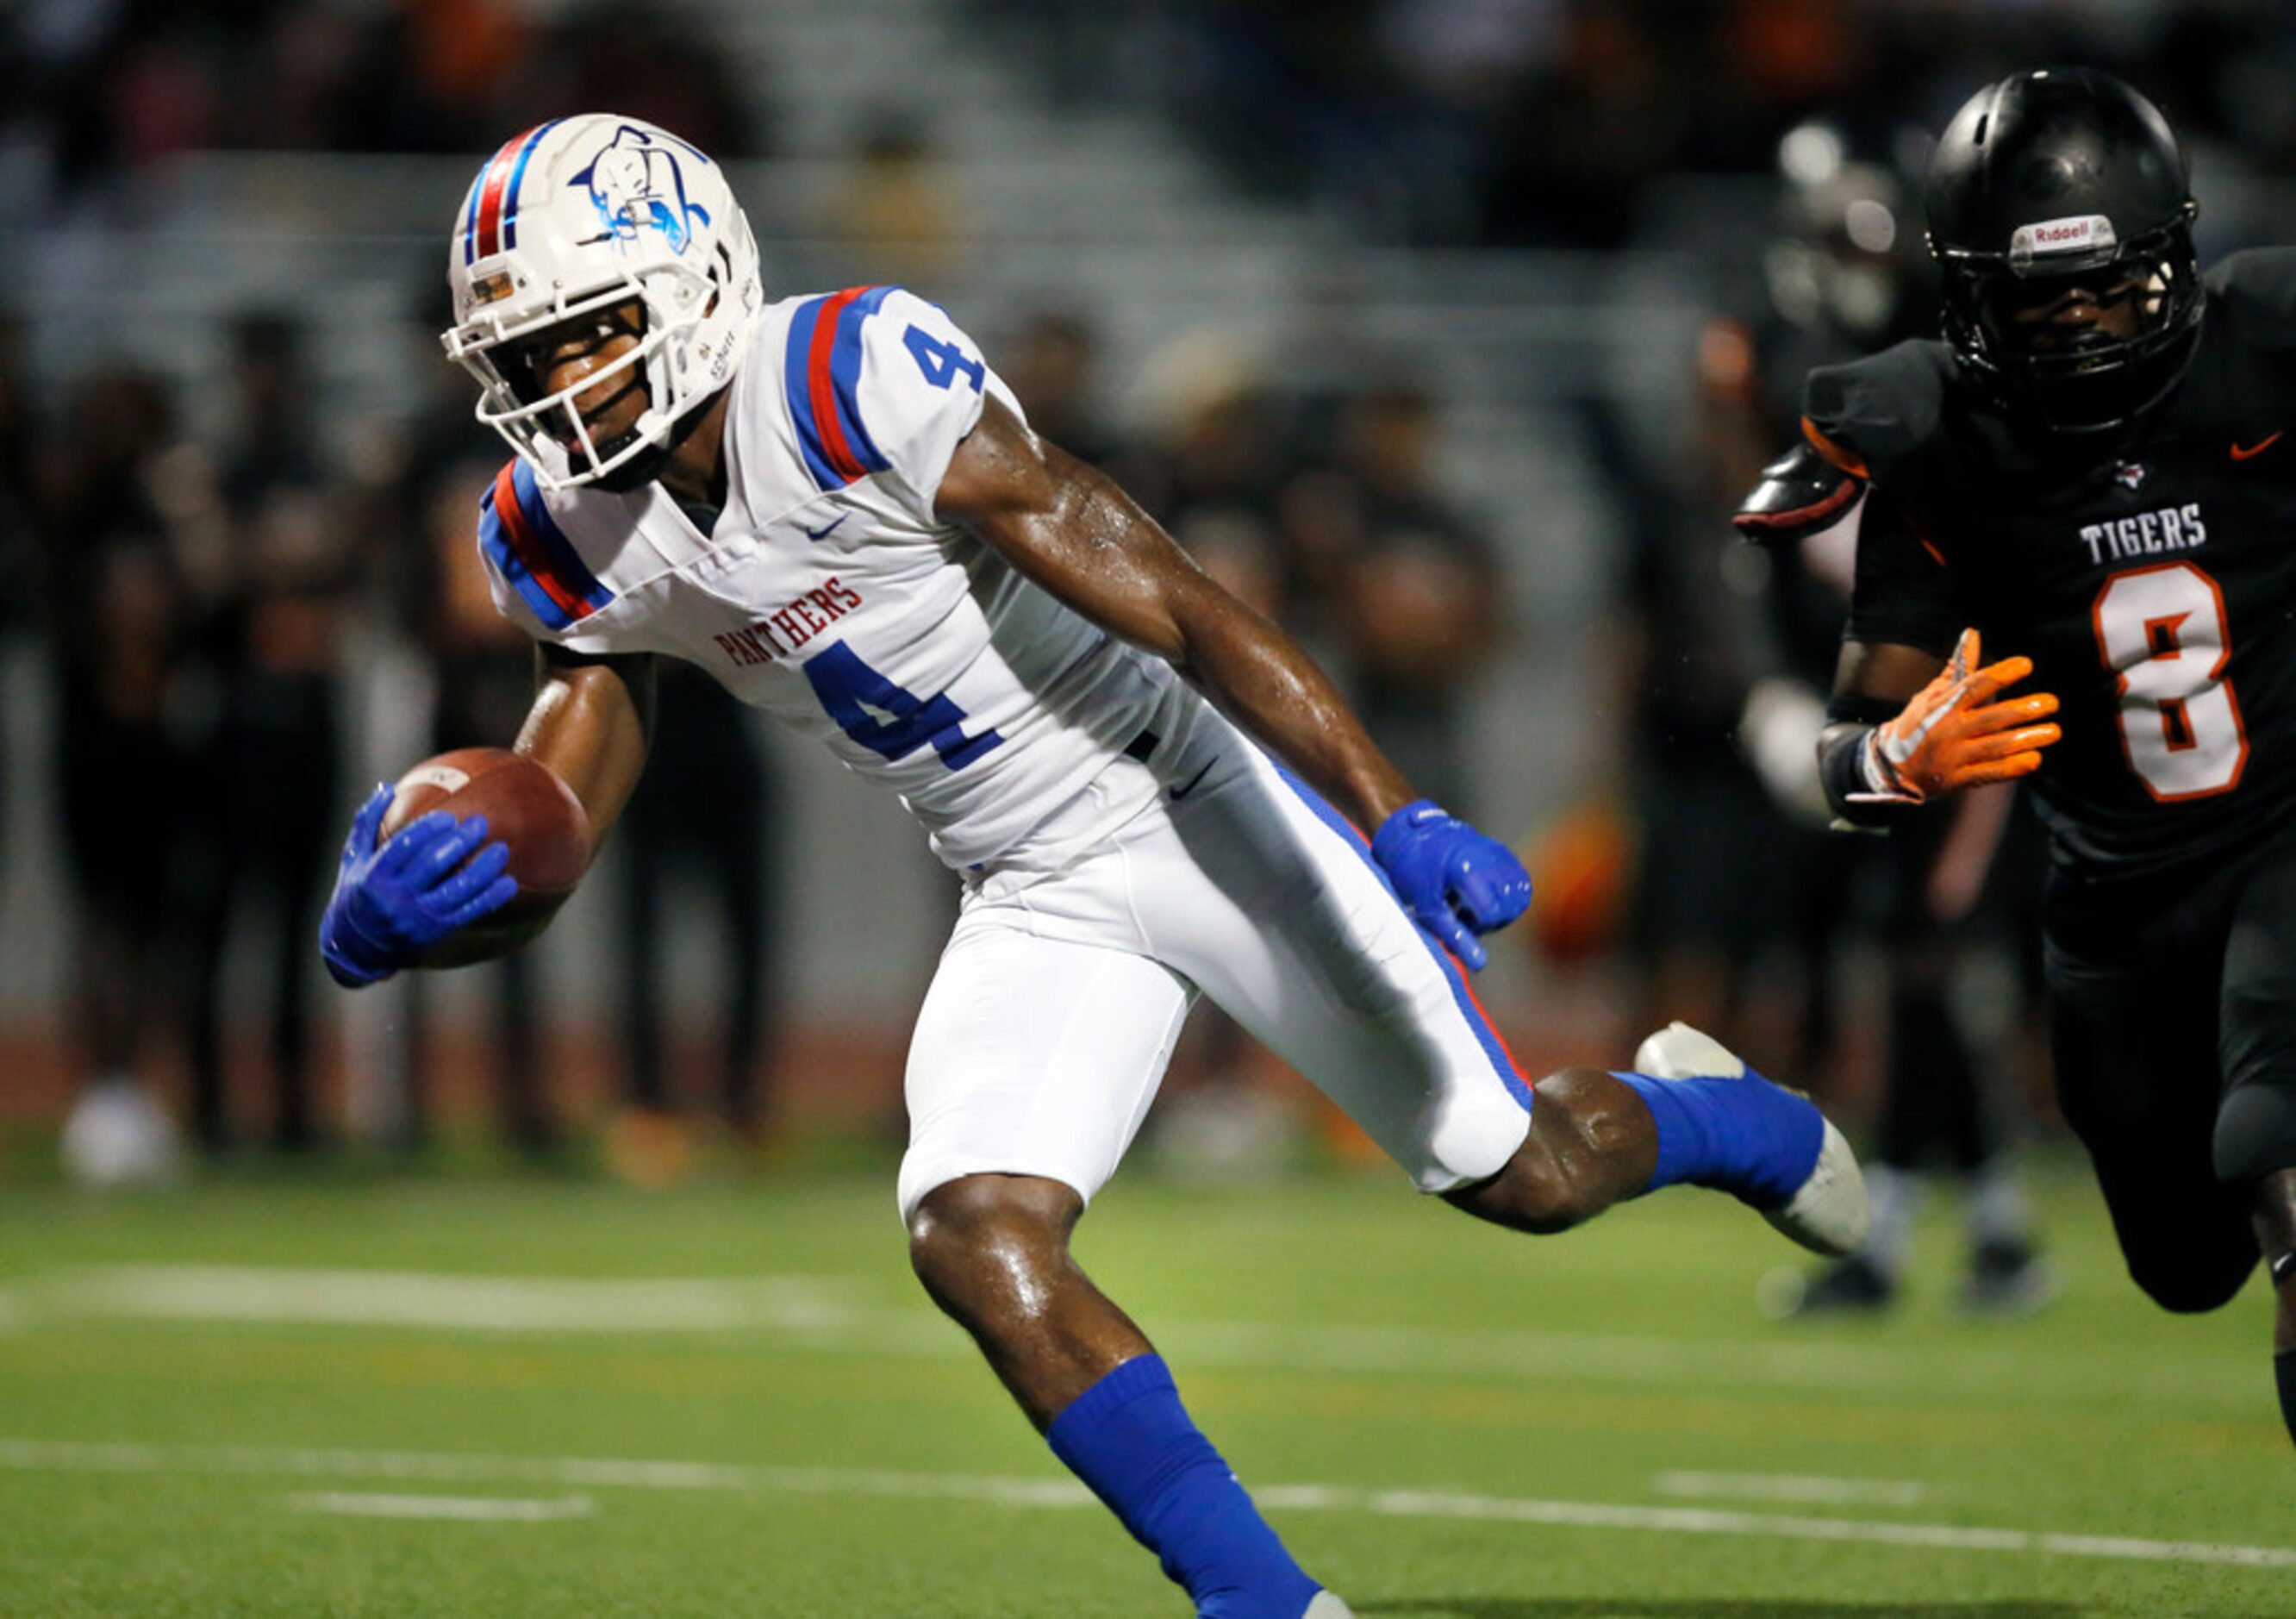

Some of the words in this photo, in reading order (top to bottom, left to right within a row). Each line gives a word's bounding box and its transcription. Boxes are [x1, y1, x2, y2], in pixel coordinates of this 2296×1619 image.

[2035, 221, 2089, 242] Riddell
[902, 323, 985, 396] 4
[2080, 503, 2206, 565] TIGERS
[714, 577, 862, 666] PANTHERS
[802, 638, 1006, 772] 4
[2092, 560, 2250, 803] 8
